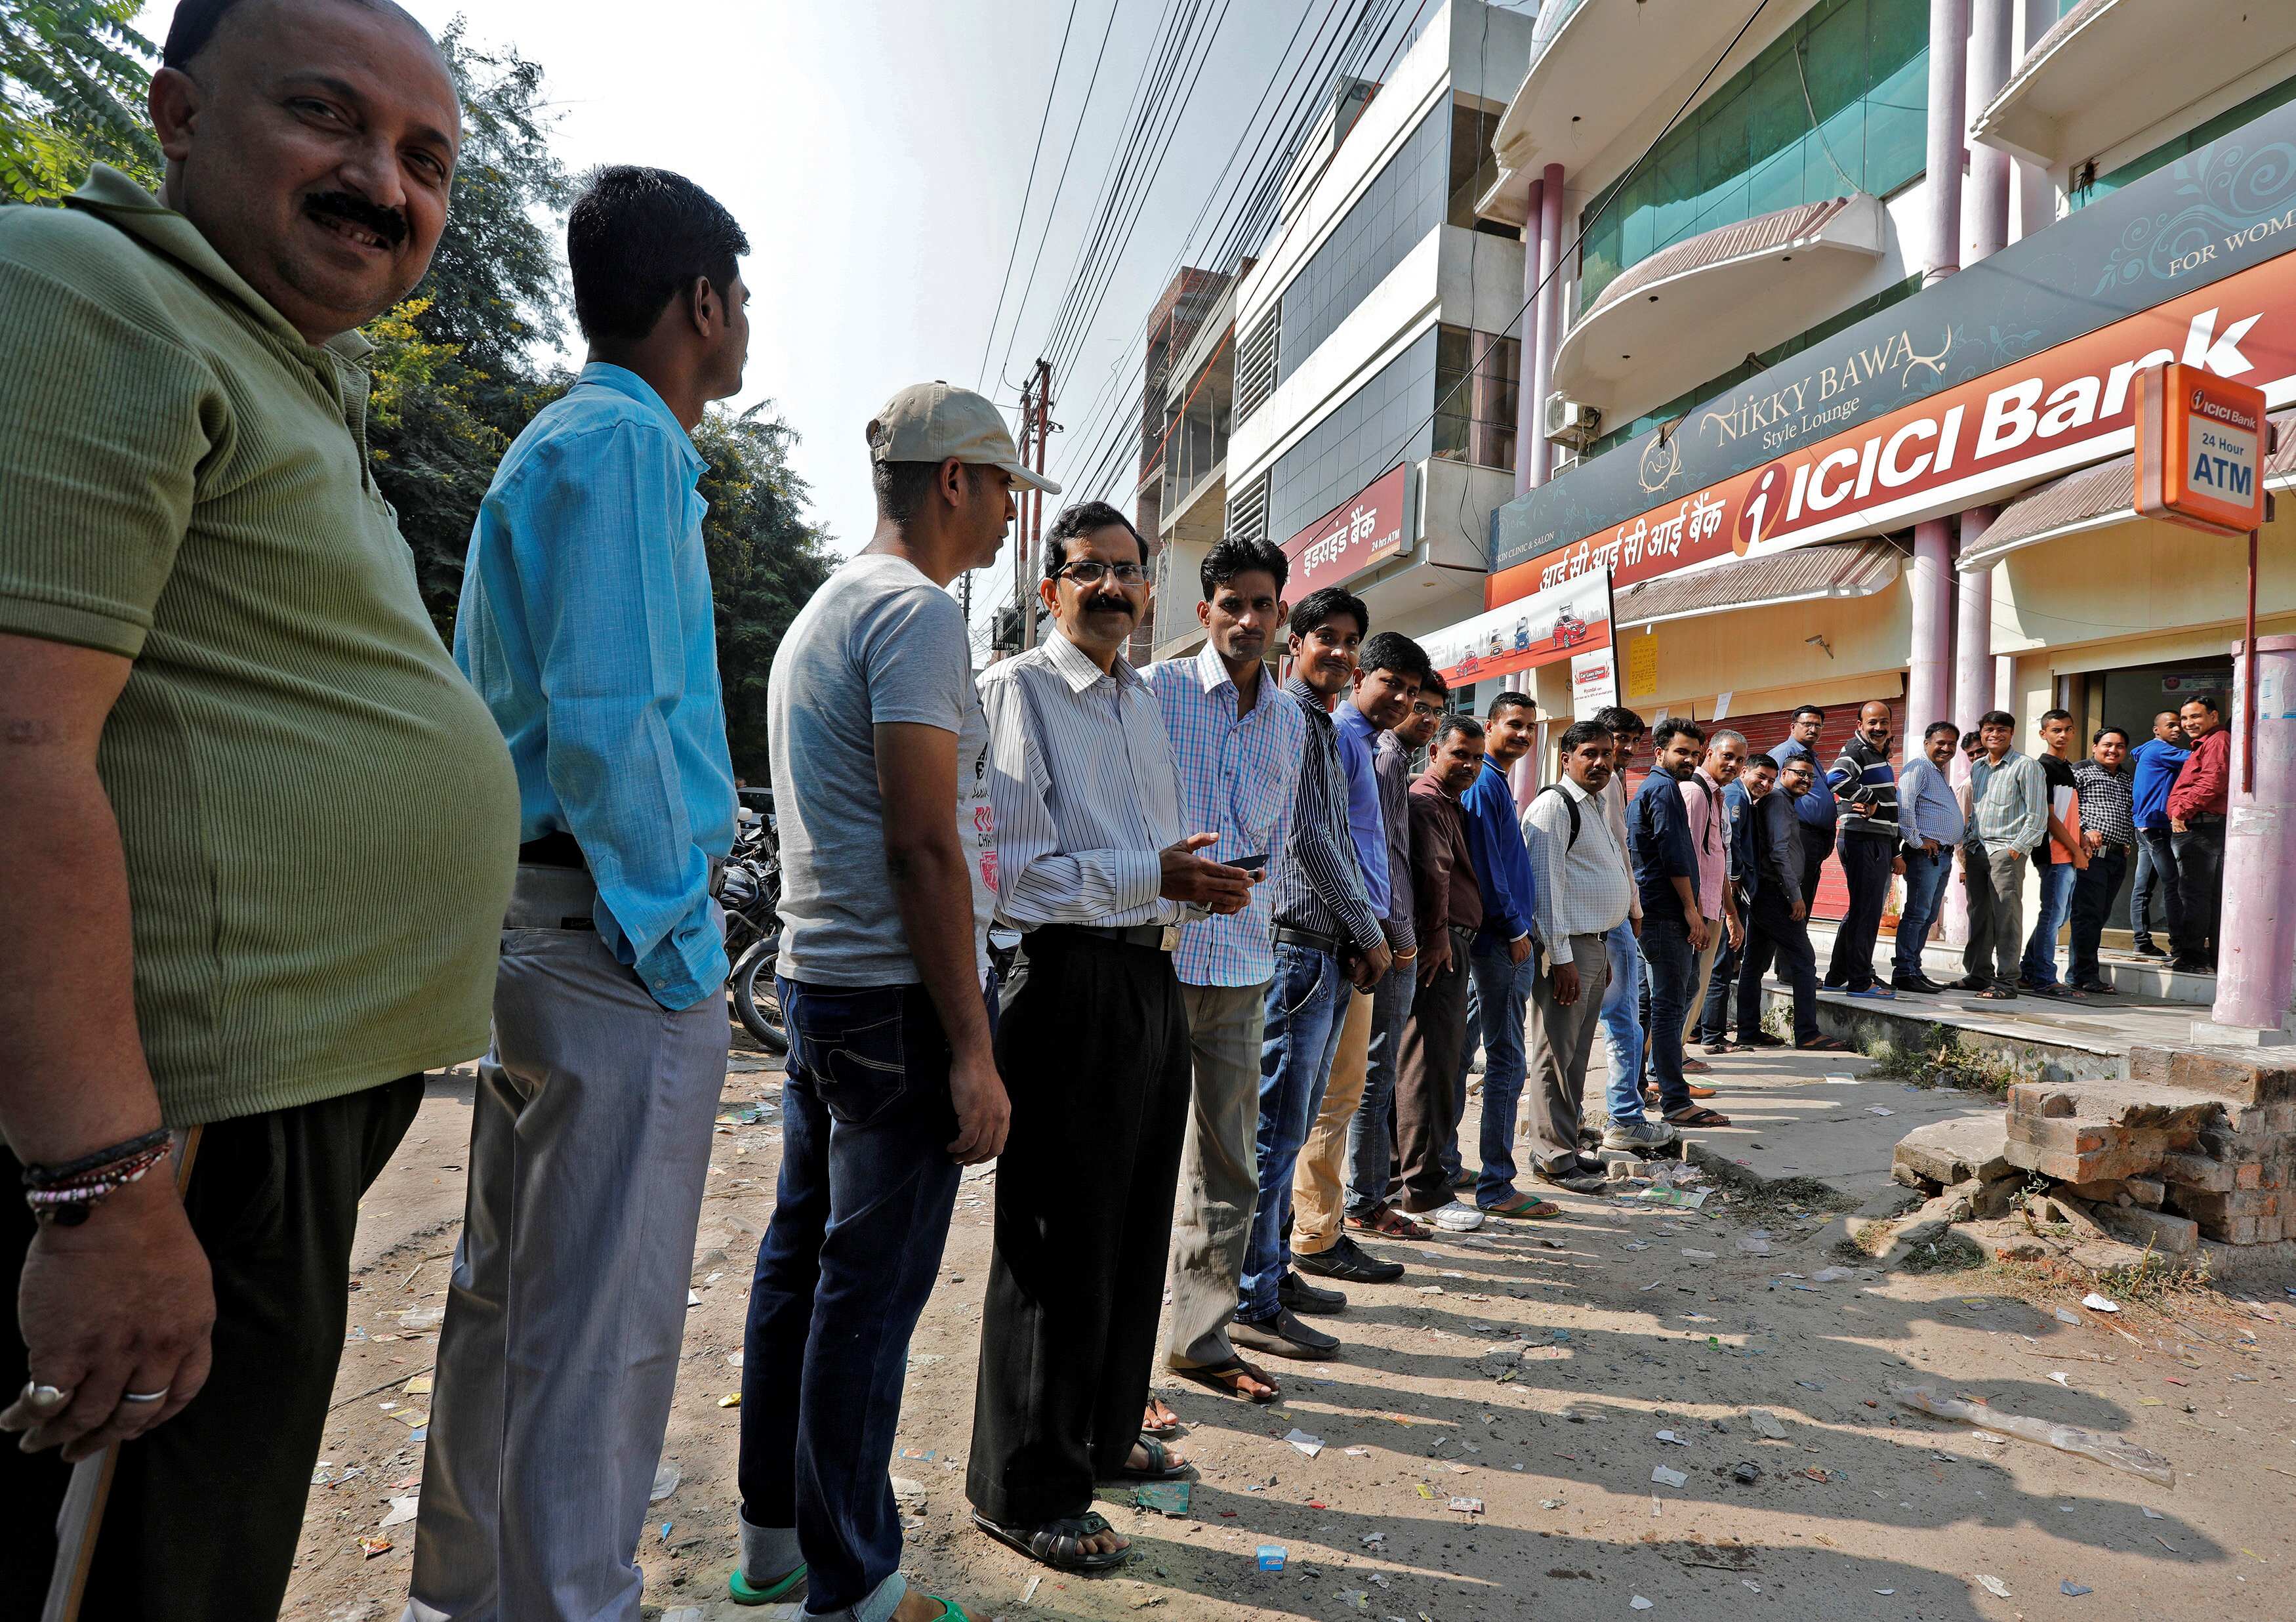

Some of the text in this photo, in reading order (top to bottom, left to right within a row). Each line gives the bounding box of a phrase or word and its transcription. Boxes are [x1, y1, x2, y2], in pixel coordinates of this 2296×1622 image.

[2167, 244, 2219, 278] FOR
[1818, 324, 1952, 402] BAWA
[1763, 396, 1860, 450] Style Lounge
[1786, 404, 1966, 523] ICICI
[1973, 306, 2265, 461] Bank
[2204, 402, 2231, 420] ICICI
[2232, 411, 2257, 429] Bank
[2202, 432, 2245, 456] 24 Hour
[2193, 453, 2252, 497] ATM
[1350, 504, 1378, 545] बैंक
[1371, 540, 1378, 552] 24
[1378, 537, 1387, 549] hrs
[1387, 528, 1400, 545] ATM
[1647, 501, 1690, 558] आई
[1689, 491, 1727, 544] बैंक
[1496, 531, 1555, 563] SKIN CLINIC & SALON
